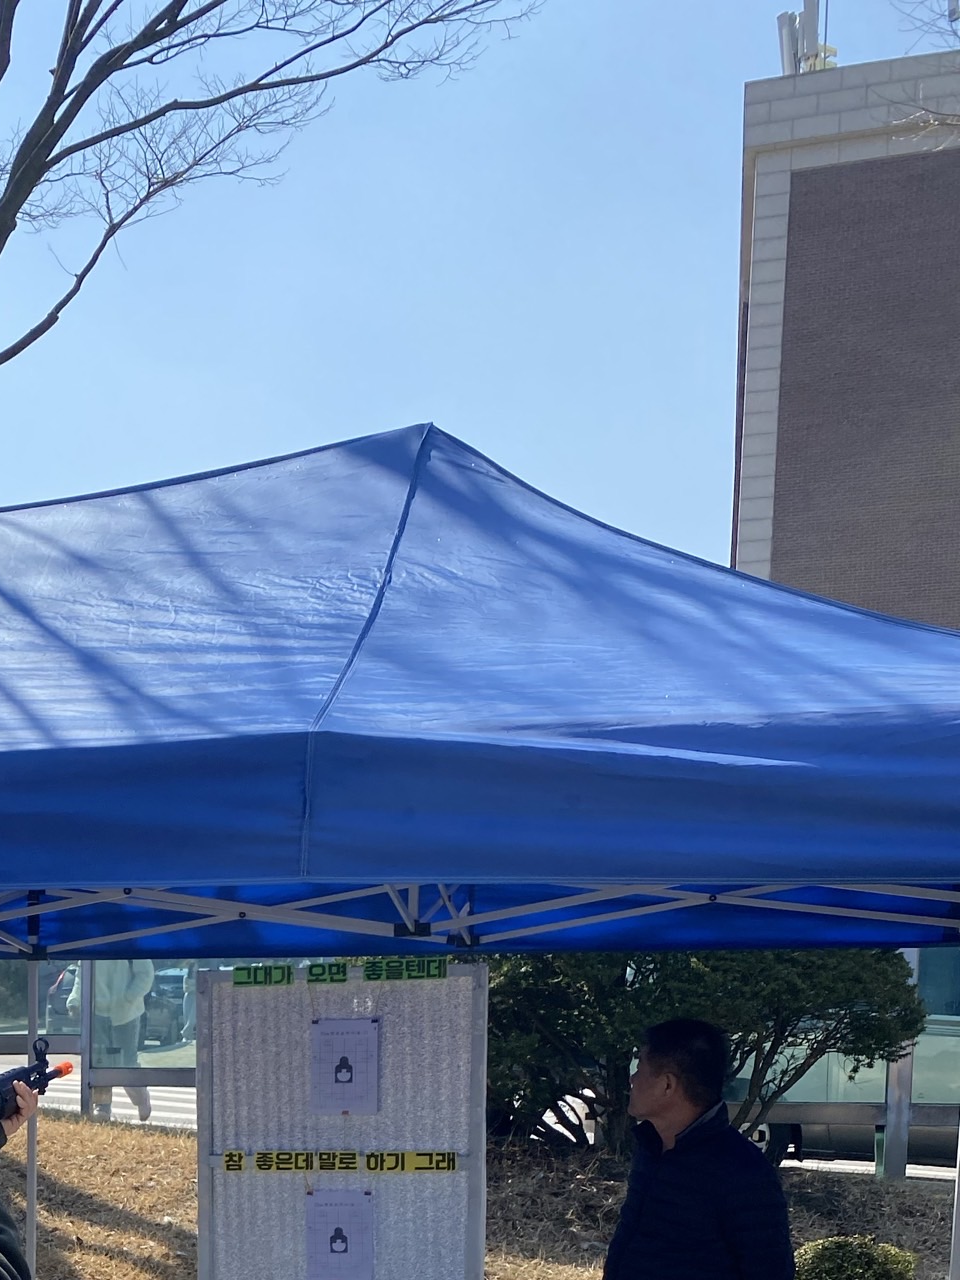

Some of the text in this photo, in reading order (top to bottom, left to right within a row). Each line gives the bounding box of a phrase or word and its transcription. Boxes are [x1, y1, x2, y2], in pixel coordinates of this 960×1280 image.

[234, 958, 447, 986] 그대가 오면 좋을텐데
[224, 1151, 456, 1172] 참 좋은데 말로 하기 그래
